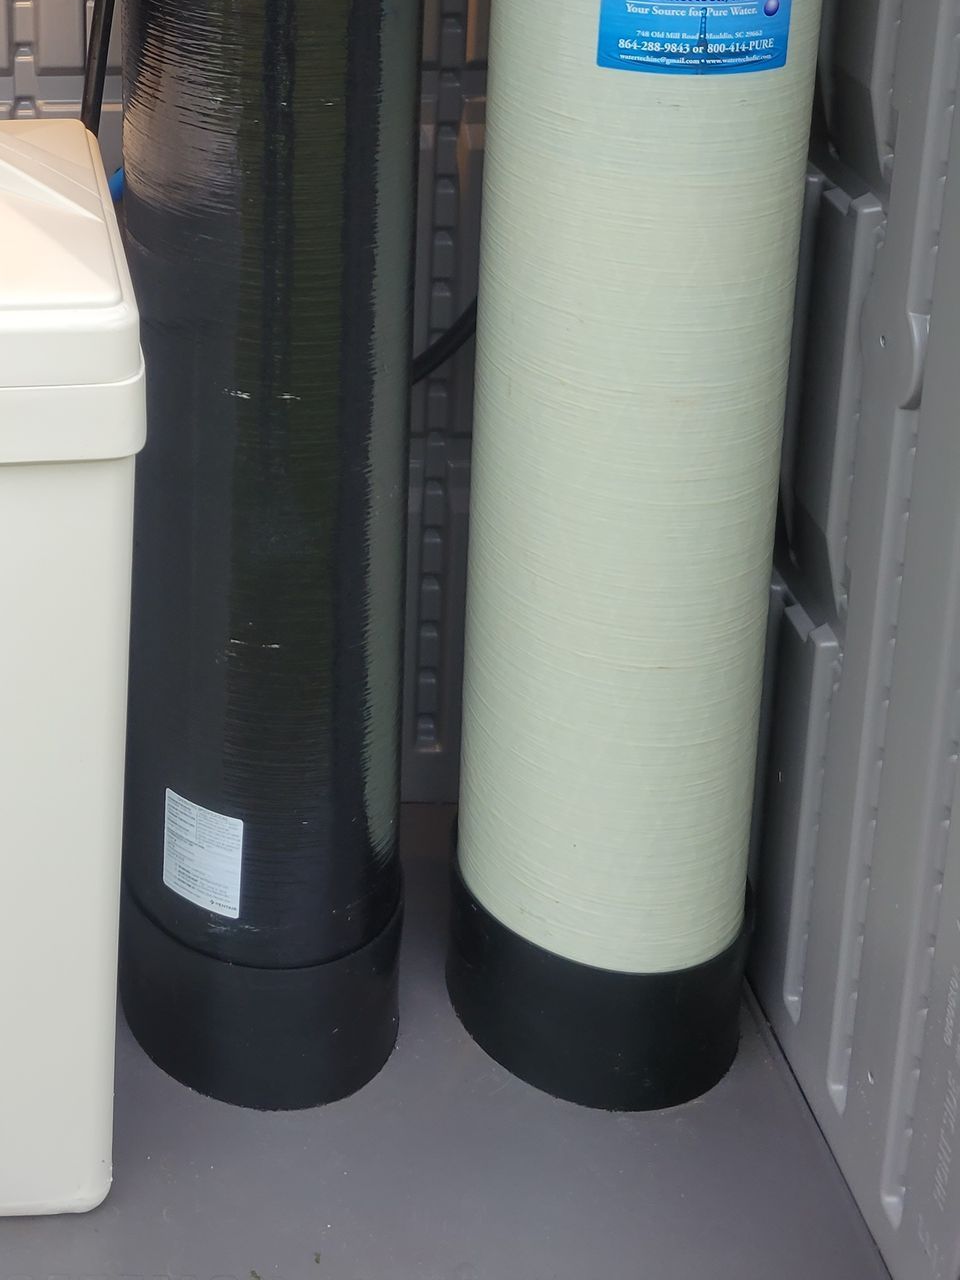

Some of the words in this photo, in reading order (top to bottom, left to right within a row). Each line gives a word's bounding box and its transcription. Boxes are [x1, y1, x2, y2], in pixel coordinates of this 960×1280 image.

[626, 3, 651, 15] Your
[651, 5, 687, 16] Source
[688, 5, 704, 17] for
[706, 6, 729, 16] Pure
[730, 6, 758, 16] Water.
[650, 30, 665, 38] Old
[618, 38, 690, 54] 864-288-9843
[692, 46, 704, 54] or
[706, 38, 775, 54] 800-414-PURE
